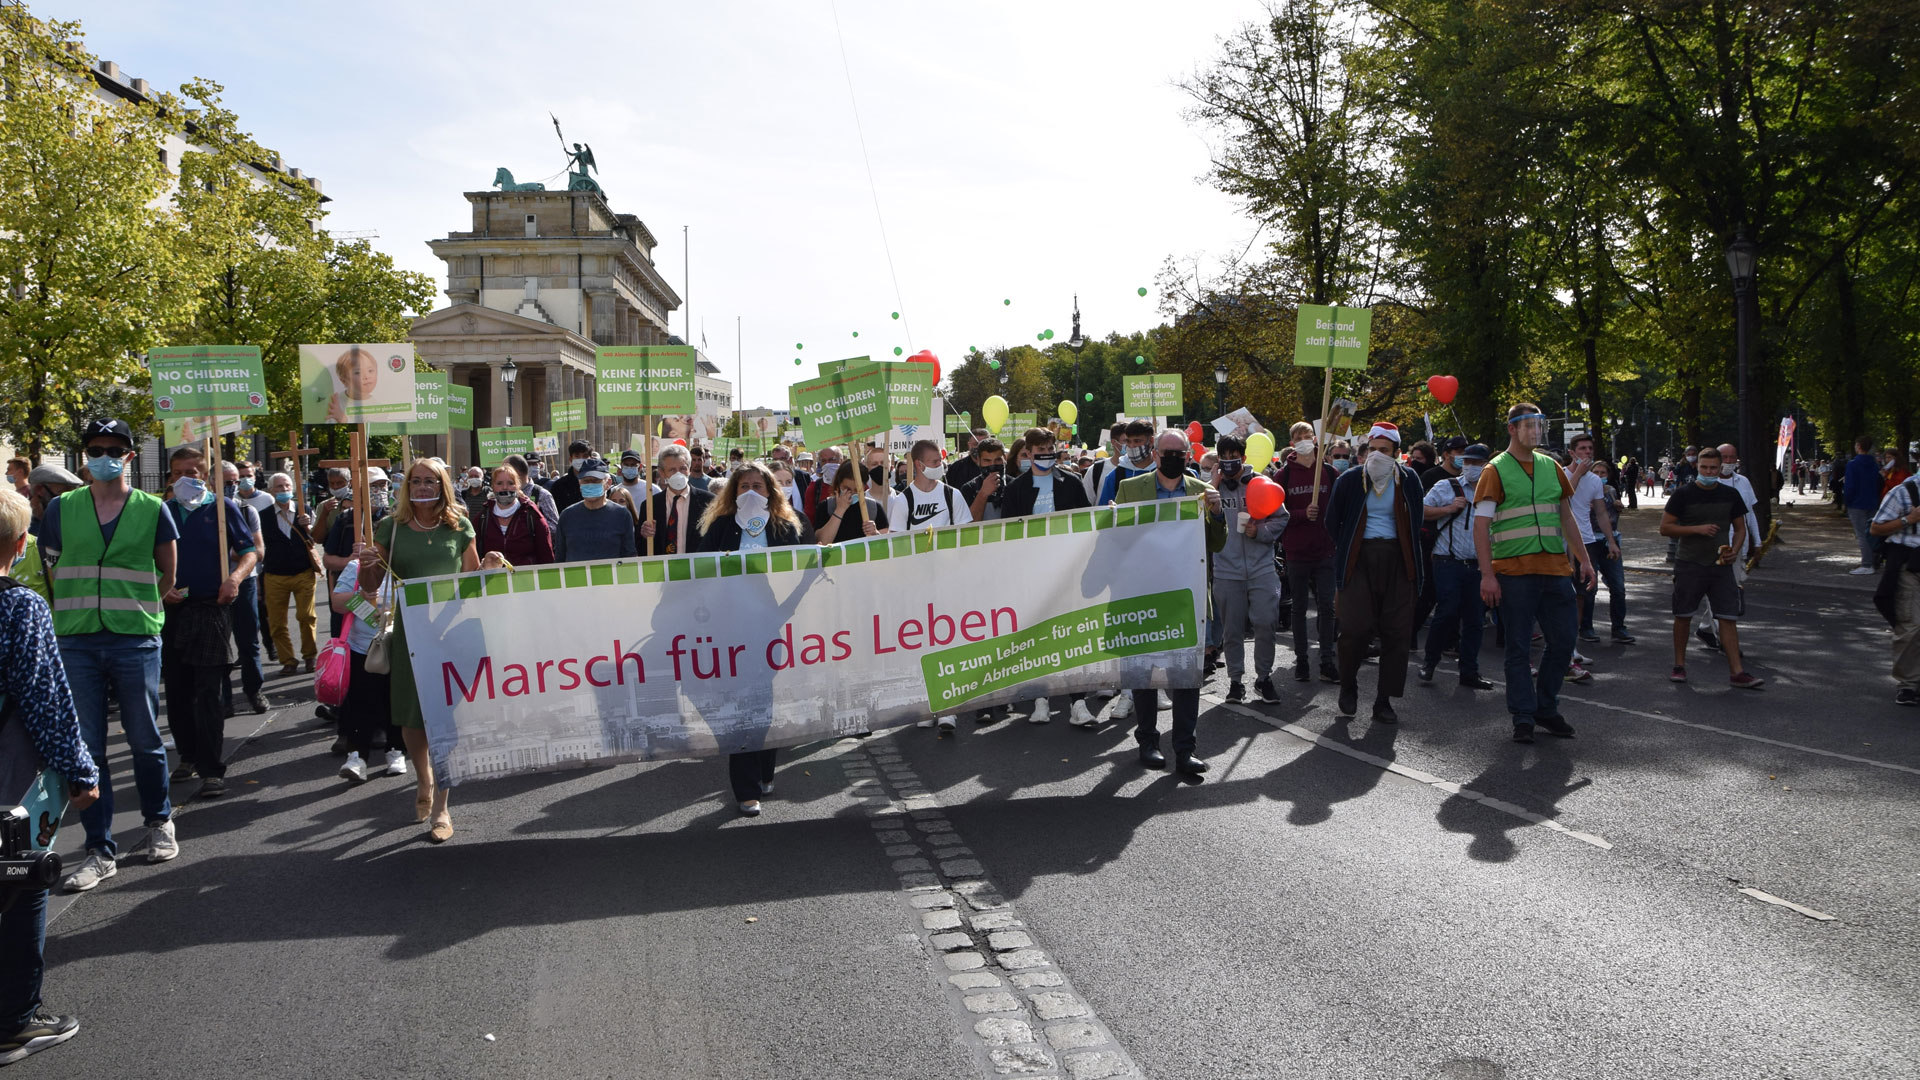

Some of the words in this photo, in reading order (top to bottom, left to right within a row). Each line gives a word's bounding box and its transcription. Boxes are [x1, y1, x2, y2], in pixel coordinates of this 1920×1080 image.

[1316, 319, 1355, 331] Beistand
[1306, 336, 1326, 346] statt
[1328, 336, 1361, 348] Beihilfe
[158, 371, 181, 380] NO
[185, 369, 250, 380] CHILDREN
[602, 369, 636, 379] KEINE
[640, 368, 682, 378] KINDER
[170, 385, 193, 394] NO
[197, 383, 249, 393] FUTURE!
[598, 383, 632, 392] KEINE
[636, 382, 693, 392] ZUKUNFT!
[885, 383, 921, 392] ILDREN
[1130, 382, 1176, 390] Selbsttötung
[428, 393, 444, 404] für
[1132, 390, 1174, 398] verhindern,
[803, 403, 822, 415] NO
[825, 388, 876, 409] CHILDREN
[888, 396, 919, 405] TURE!
[814, 415, 834, 427] NO
[836, 402, 876, 421] FUTURE!
[915, 502, 939, 516] NIKE
[938, 661, 955, 678] Ja
[960, 653, 992, 672] zum
[996, 638, 1035, 661] Leben
[1051, 625, 1072, 640] für
[1077, 618, 1099, 634] ein
[1103, 607, 1157, 627] Europa
[444, 640, 645, 704] Marsch
[667, 634, 746, 681] für
[768, 624, 852, 670] das
[874, 603, 1018, 655] Leben
[942, 680, 978, 700] ohne
[982, 652, 1060, 686] Abtreibung
[1065, 642, 1092, 660] und
[1097, 624, 1185, 652] Euthanasie!
[7, 867, 28, 875] RONIN
